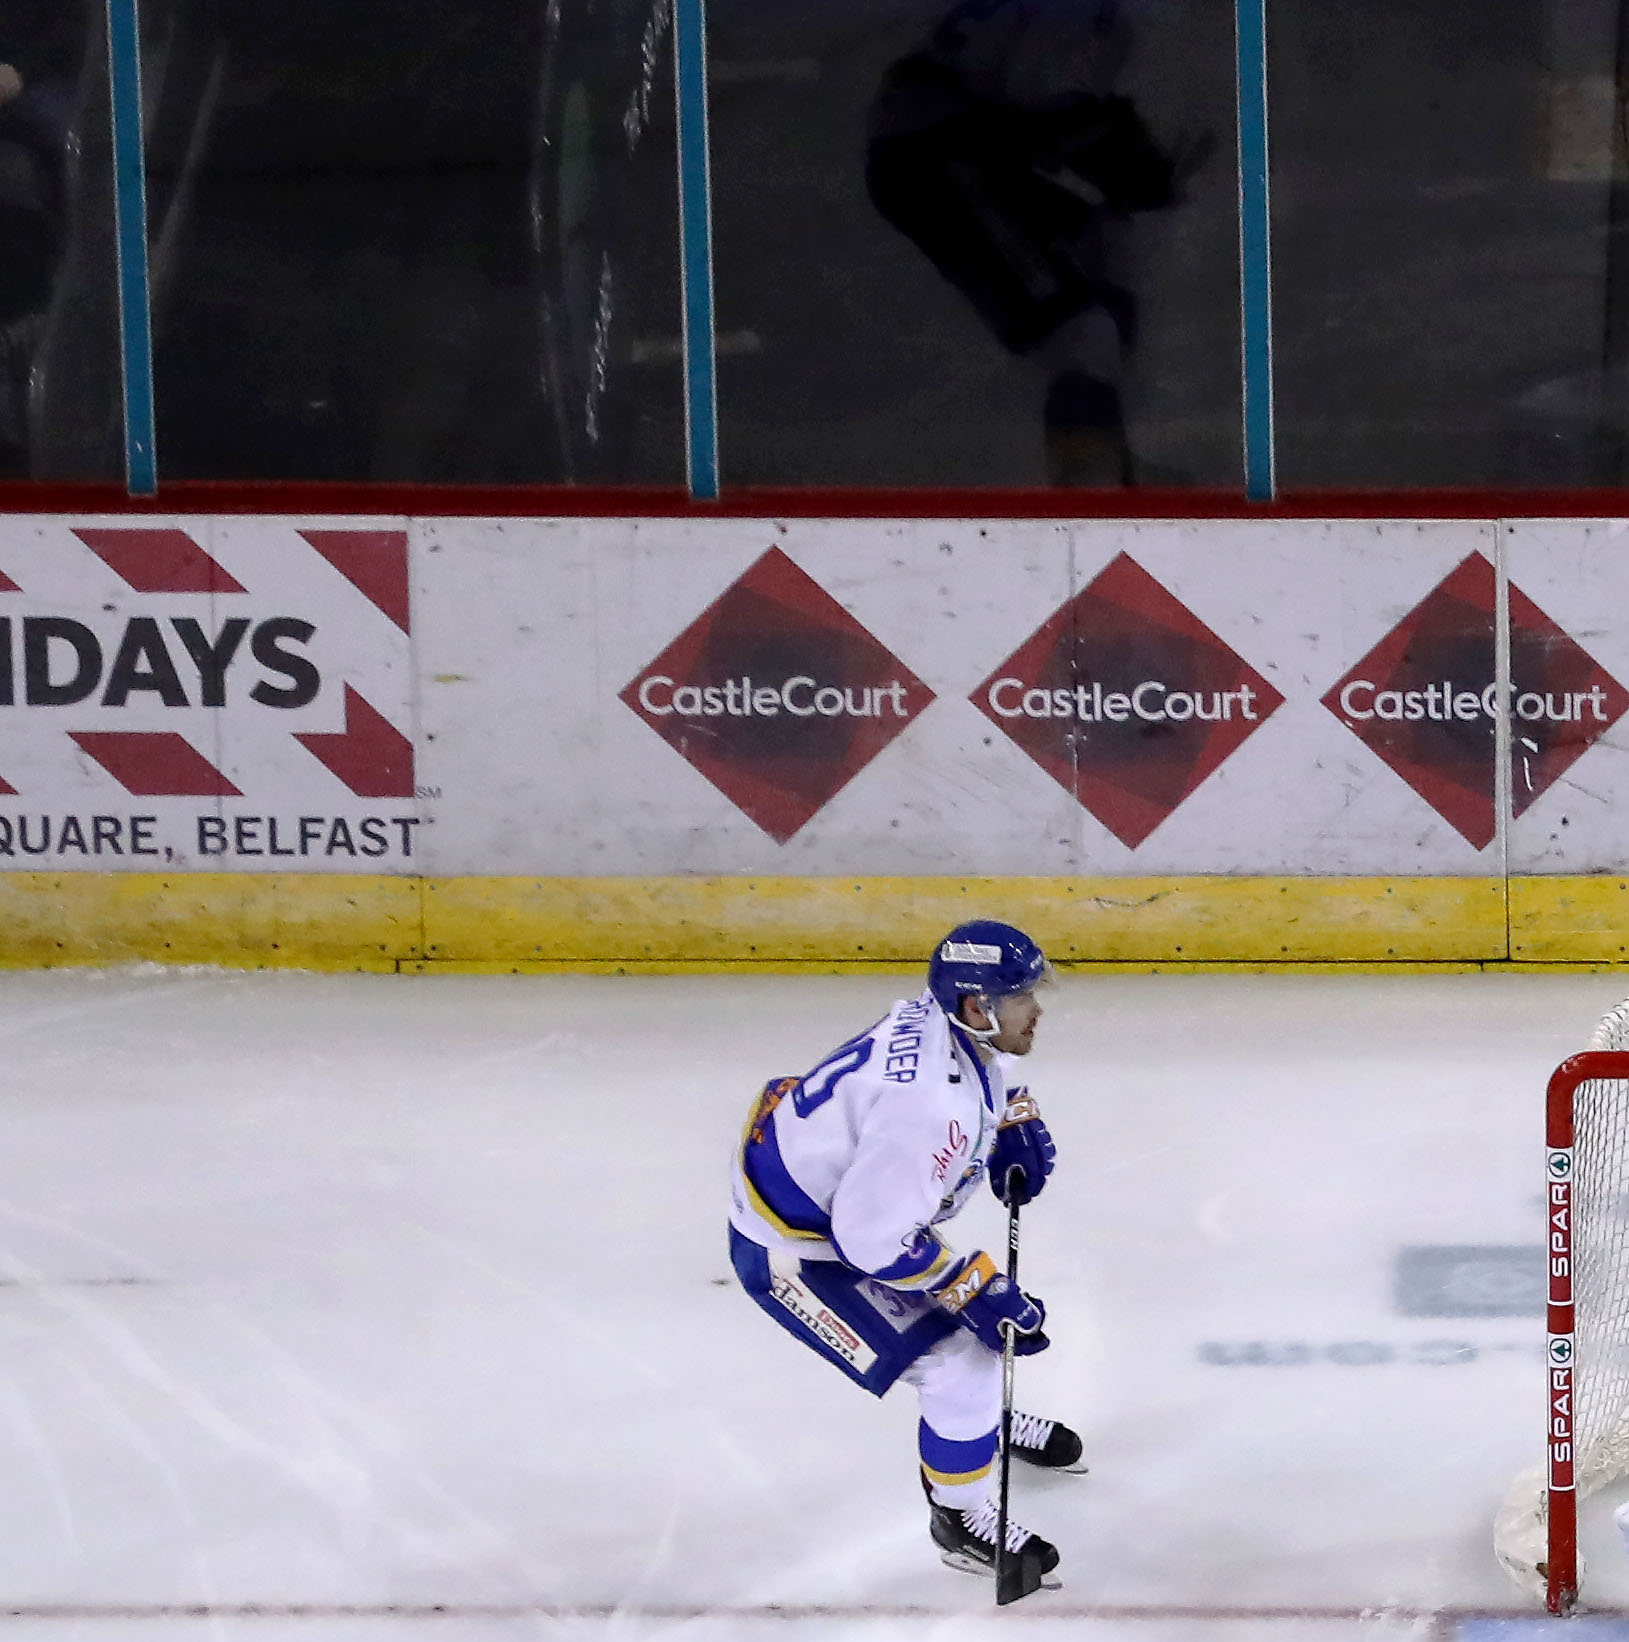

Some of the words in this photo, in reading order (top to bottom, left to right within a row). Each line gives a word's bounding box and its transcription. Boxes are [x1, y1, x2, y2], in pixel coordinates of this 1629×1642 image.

[639, 675, 907, 717] CastleCourt
[988, 676, 1258, 722] CastleCourt
[1340, 680, 1608, 722] CastleCourt
[198, 815, 421, 858] BELFAST
[1551, 1183, 1570, 1278] SPAR
[1553, 1369, 1572, 1463] SPAR
